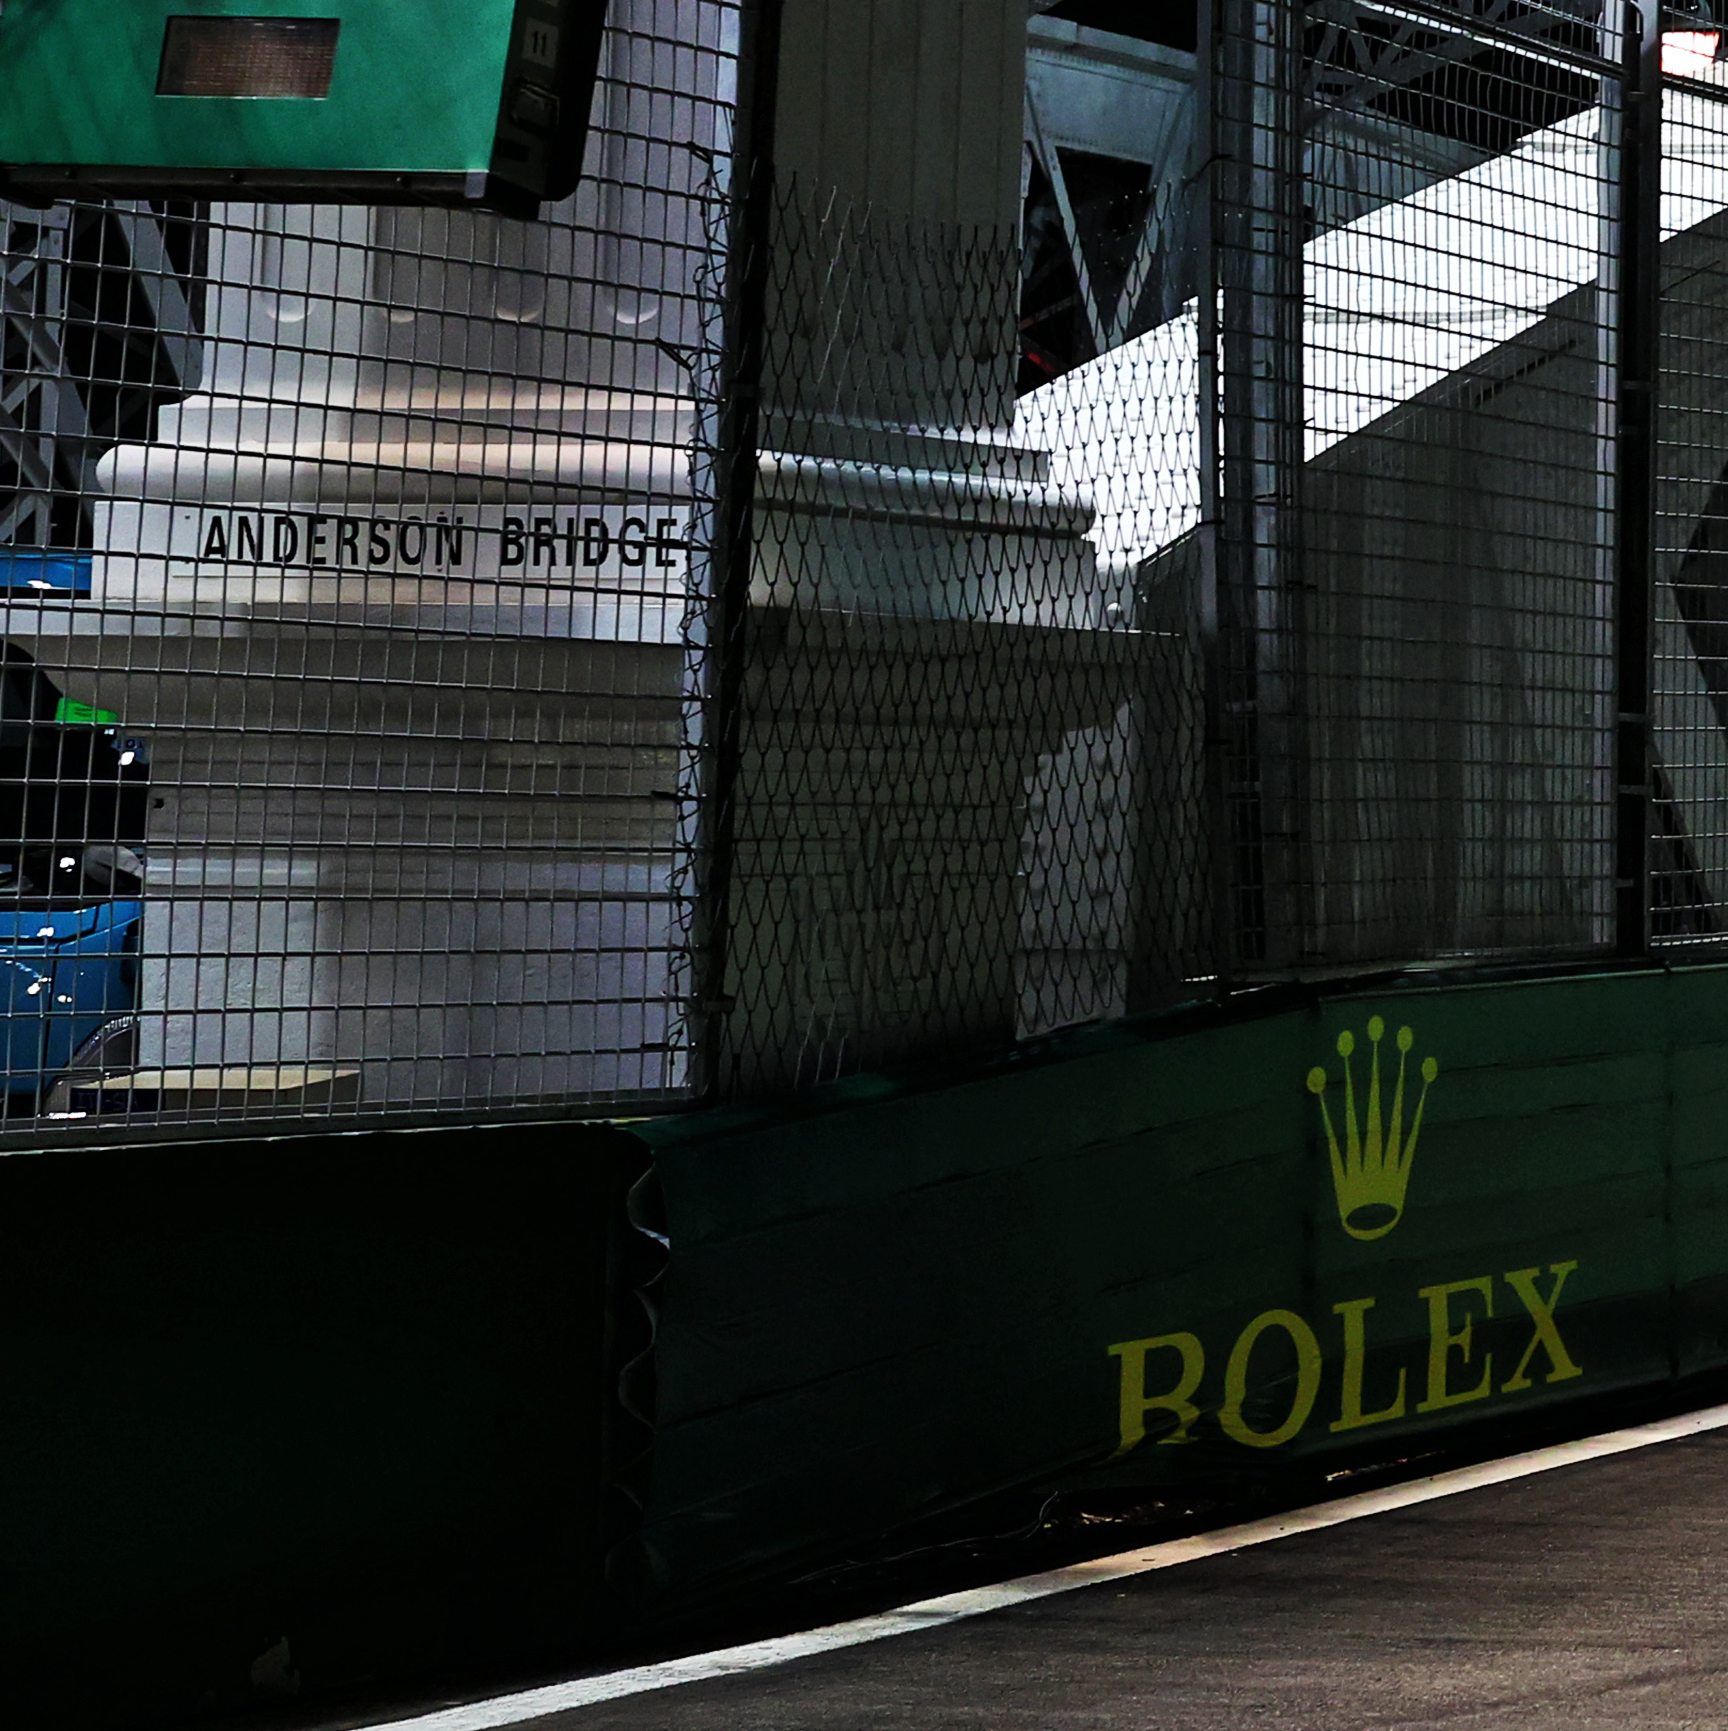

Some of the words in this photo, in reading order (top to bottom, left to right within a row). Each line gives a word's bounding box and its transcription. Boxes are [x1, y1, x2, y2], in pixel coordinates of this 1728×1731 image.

[203, 514, 464, 568] ANDERSON
[500, 516, 679, 568] BRIDGE
[1106, 1259, 1584, 1460] ROLEX
